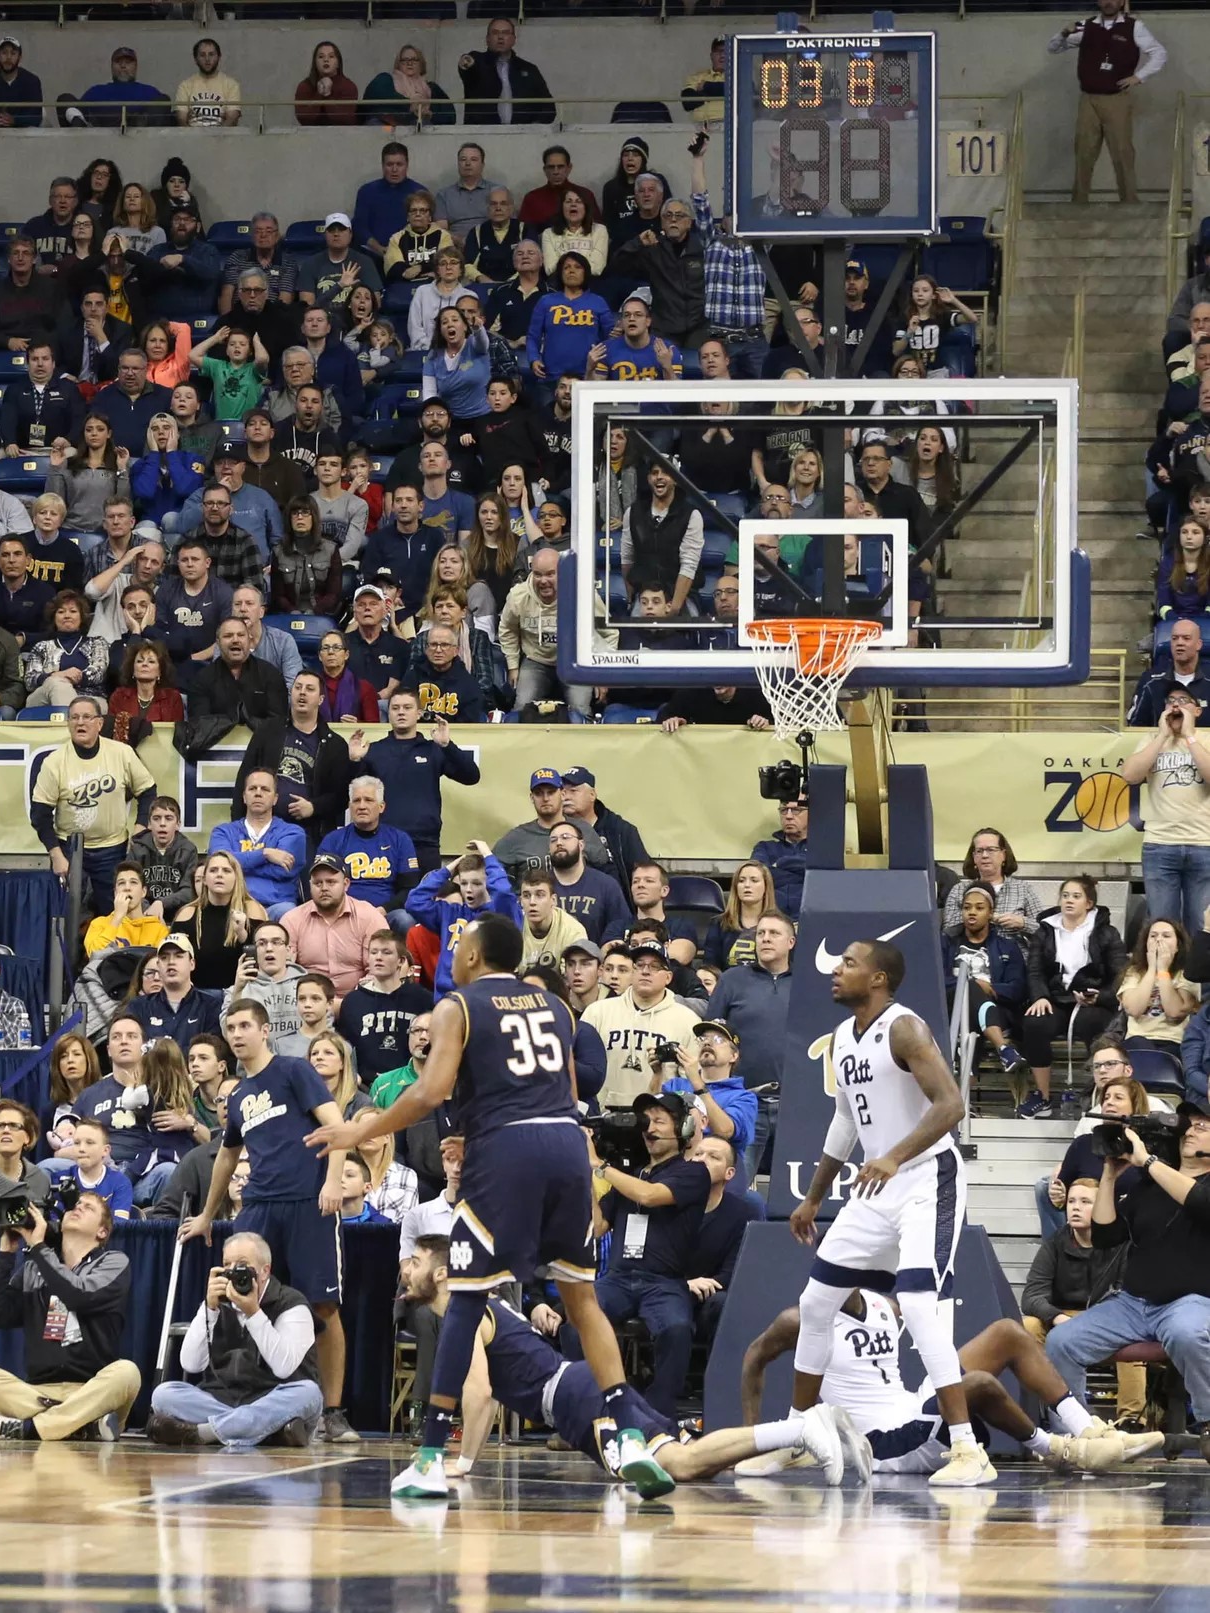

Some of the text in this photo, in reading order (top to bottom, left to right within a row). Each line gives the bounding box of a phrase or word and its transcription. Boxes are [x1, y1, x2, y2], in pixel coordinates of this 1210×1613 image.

[786, 38, 880, 49] DAKTRONICS
[760, 59, 823, 108] 03
[956, 136, 997, 174] 101
[549, 304, 595, 326] Pitt
[910, 324, 940, 350] GO
[610, 361, 658, 380] Pitt
[223, 442, 233, 452] T
[26, 560, 66, 583] PITT
[174, 607, 204, 627] Pitt
[591, 654, 639, 666] SPALDING
[418, 682, 459, 716] Pitt
[534, 768, 554, 779] Pitt
[1043, 757, 1124, 768] OAKLA
[72, 773, 117, 806] ZOO
[344, 851, 392, 880] Pitt
[526, 855, 552, 872] PI
[150, 885, 172, 899] Pitt
[562, 895, 596, 915] ITT
[263, 993, 298, 1007] NTHER
[491, 993, 548, 1011] COLSON II
[360, 1010, 417, 1037] PITT
[499, 1011, 564, 1076] 35
[606, 1029, 667, 1051] PITT
[840, 1055, 873, 1086] Pitt
[94, 1099, 113, 1116] GO
[239, 1089, 273, 1122] Pitt
[855, 1094, 872, 1126] 2
[786, 1161, 862, 1201] UP
[845, 1328, 894, 1357] Pitt
[873, 1360, 890, 1385] 1
